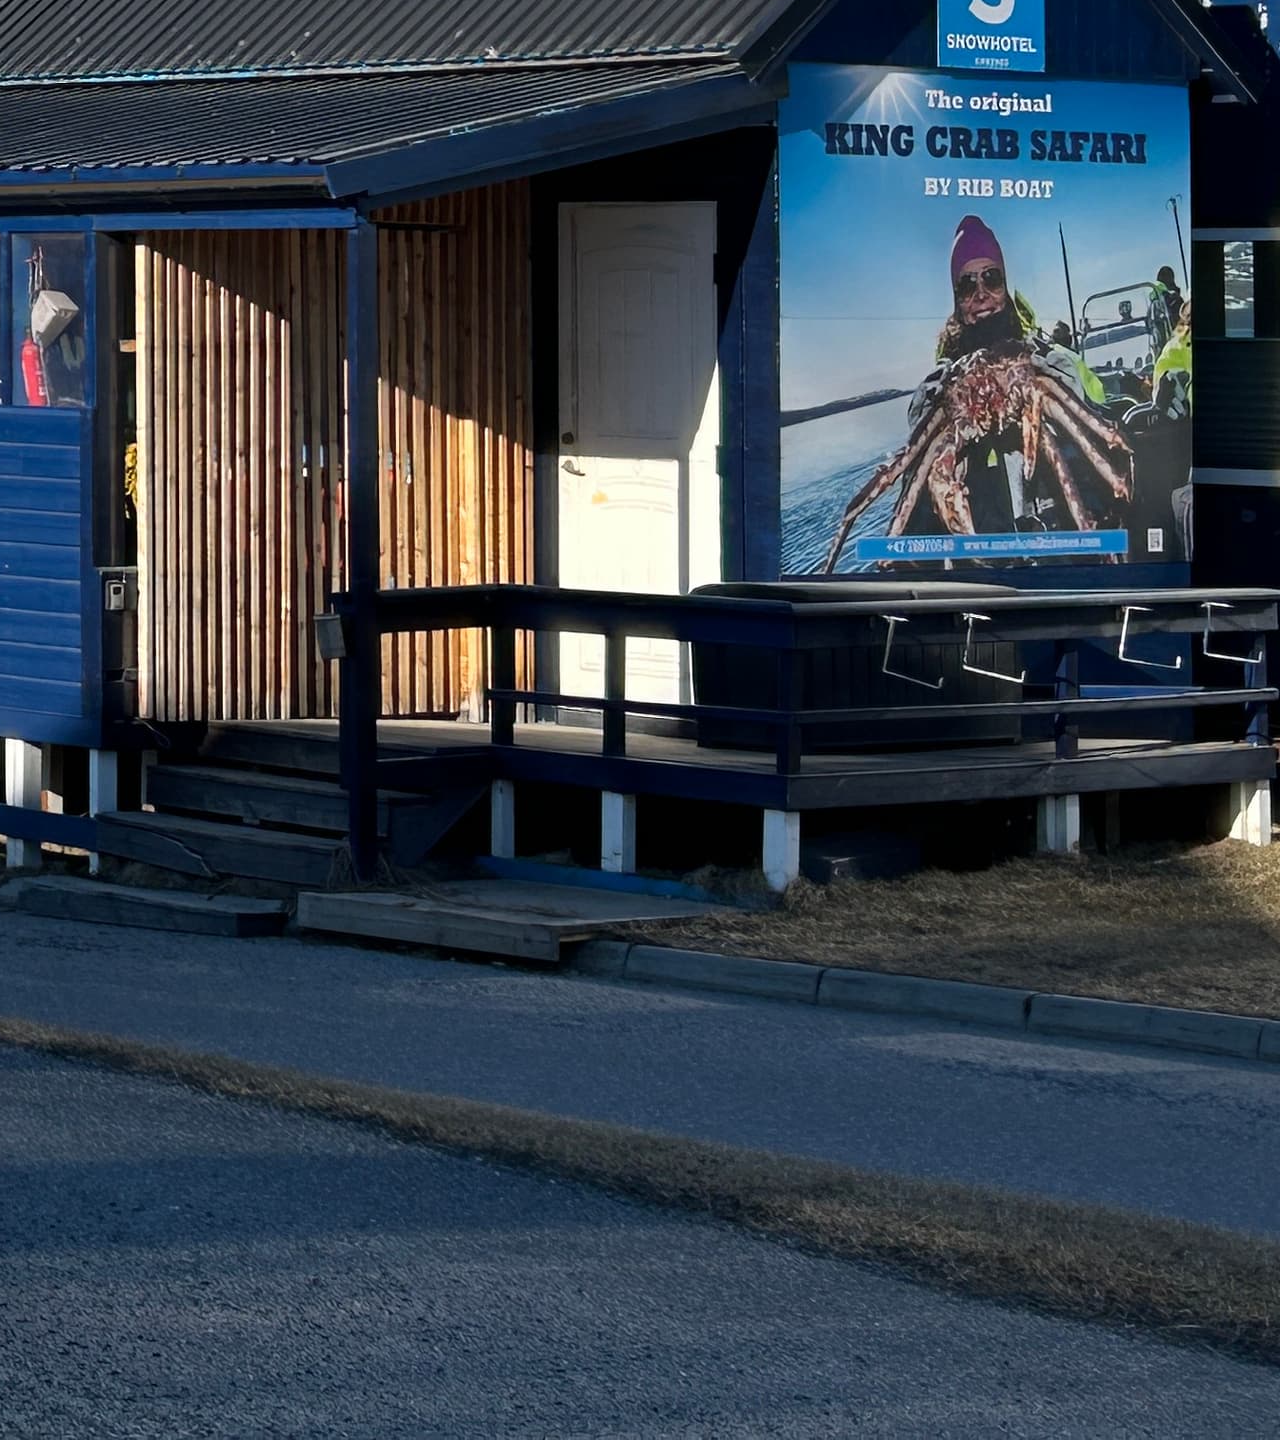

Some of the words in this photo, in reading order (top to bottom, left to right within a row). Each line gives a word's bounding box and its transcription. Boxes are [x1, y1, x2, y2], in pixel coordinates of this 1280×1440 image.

[946, 32, 1037, 53] SNOWHOTEL
[925, 89, 963, 110] The
[969, 92, 1053, 116] original
[824, 122, 915, 158] KING
[925, 126, 1020, 161] CRAB
[1030, 130, 1148, 165] SAFARI
[924, 177, 950, 197] BY
[956, 178, 995, 198] RIB
[999, 179, 1055, 199] BOAT
